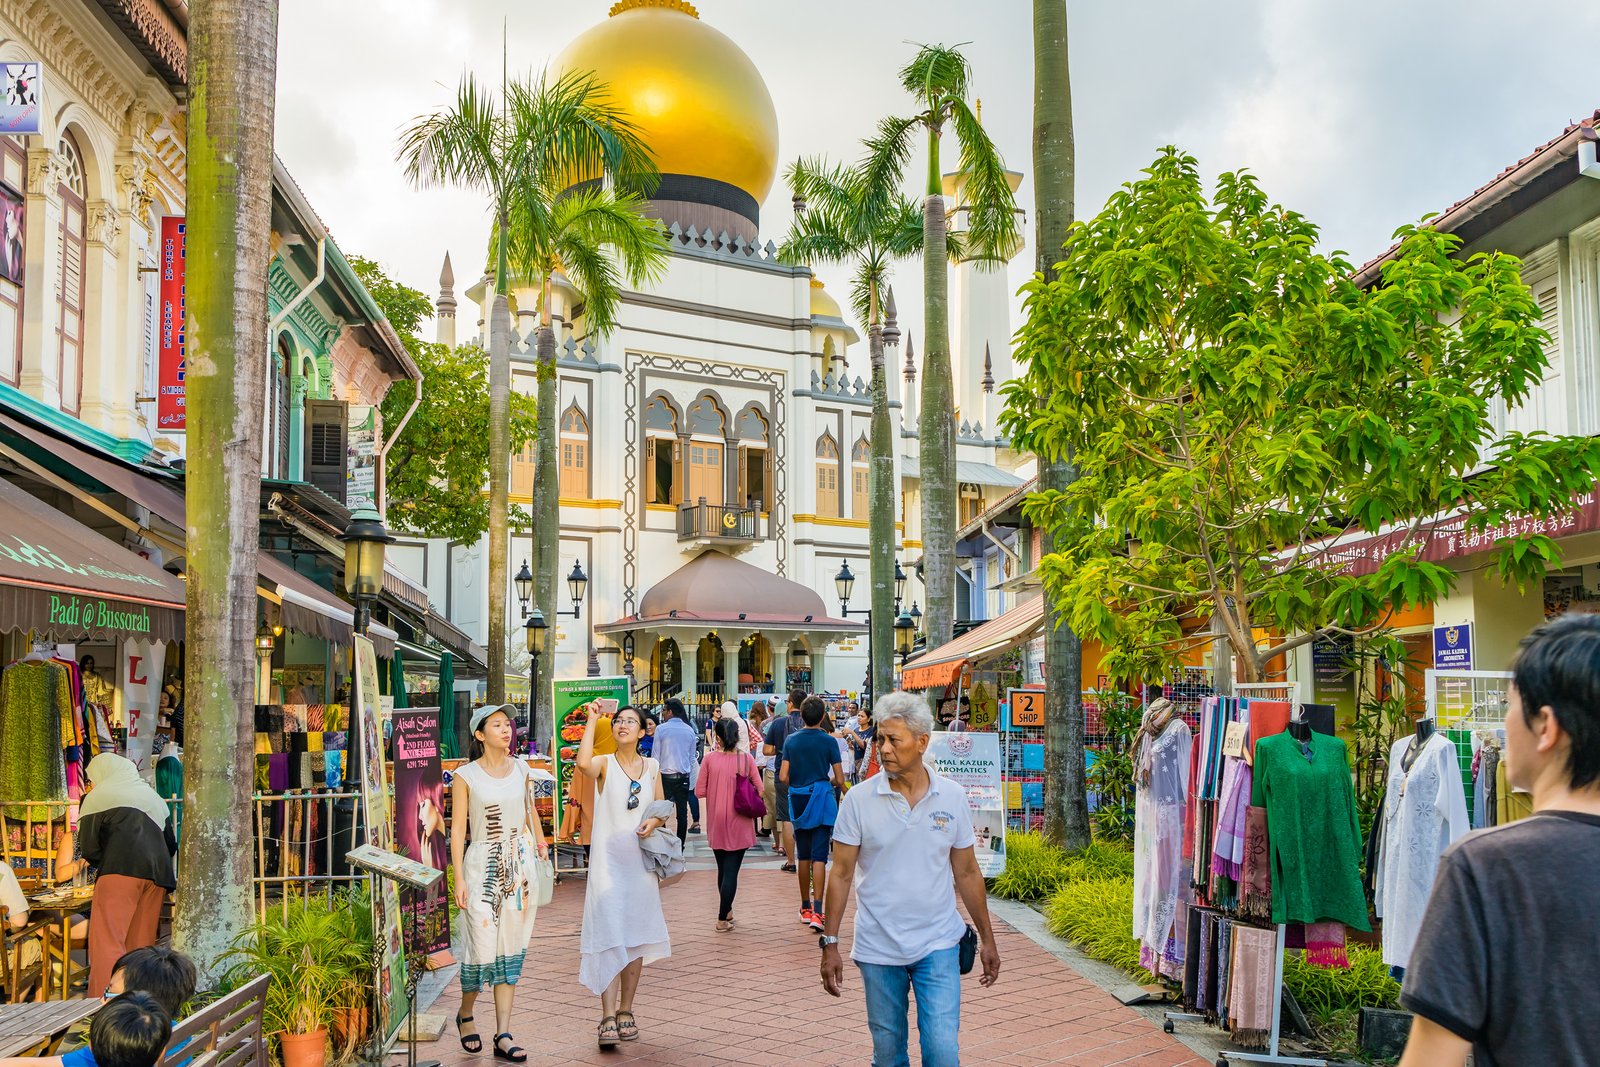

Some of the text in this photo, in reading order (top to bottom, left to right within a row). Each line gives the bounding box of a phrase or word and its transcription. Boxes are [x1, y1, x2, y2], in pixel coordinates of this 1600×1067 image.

[165, 239, 174, 280] TURKISH
[164, 300, 172, 348] LEBANESE
[1576, 492, 1594, 506] OIL
[50, 595, 150, 633] Padi @ Bussorah
[1019, 696, 1034, 712] $2
[416, 715, 437, 732] Salon
[975, 713, 989, 723] SG
[1019, 713, 1038, 723] SHOP
[406, 739, 436, 750] 2ND FLOOR
[937, 766, 988, 774] AROMATICS
[960, 759, 995, 767] KAZURA
